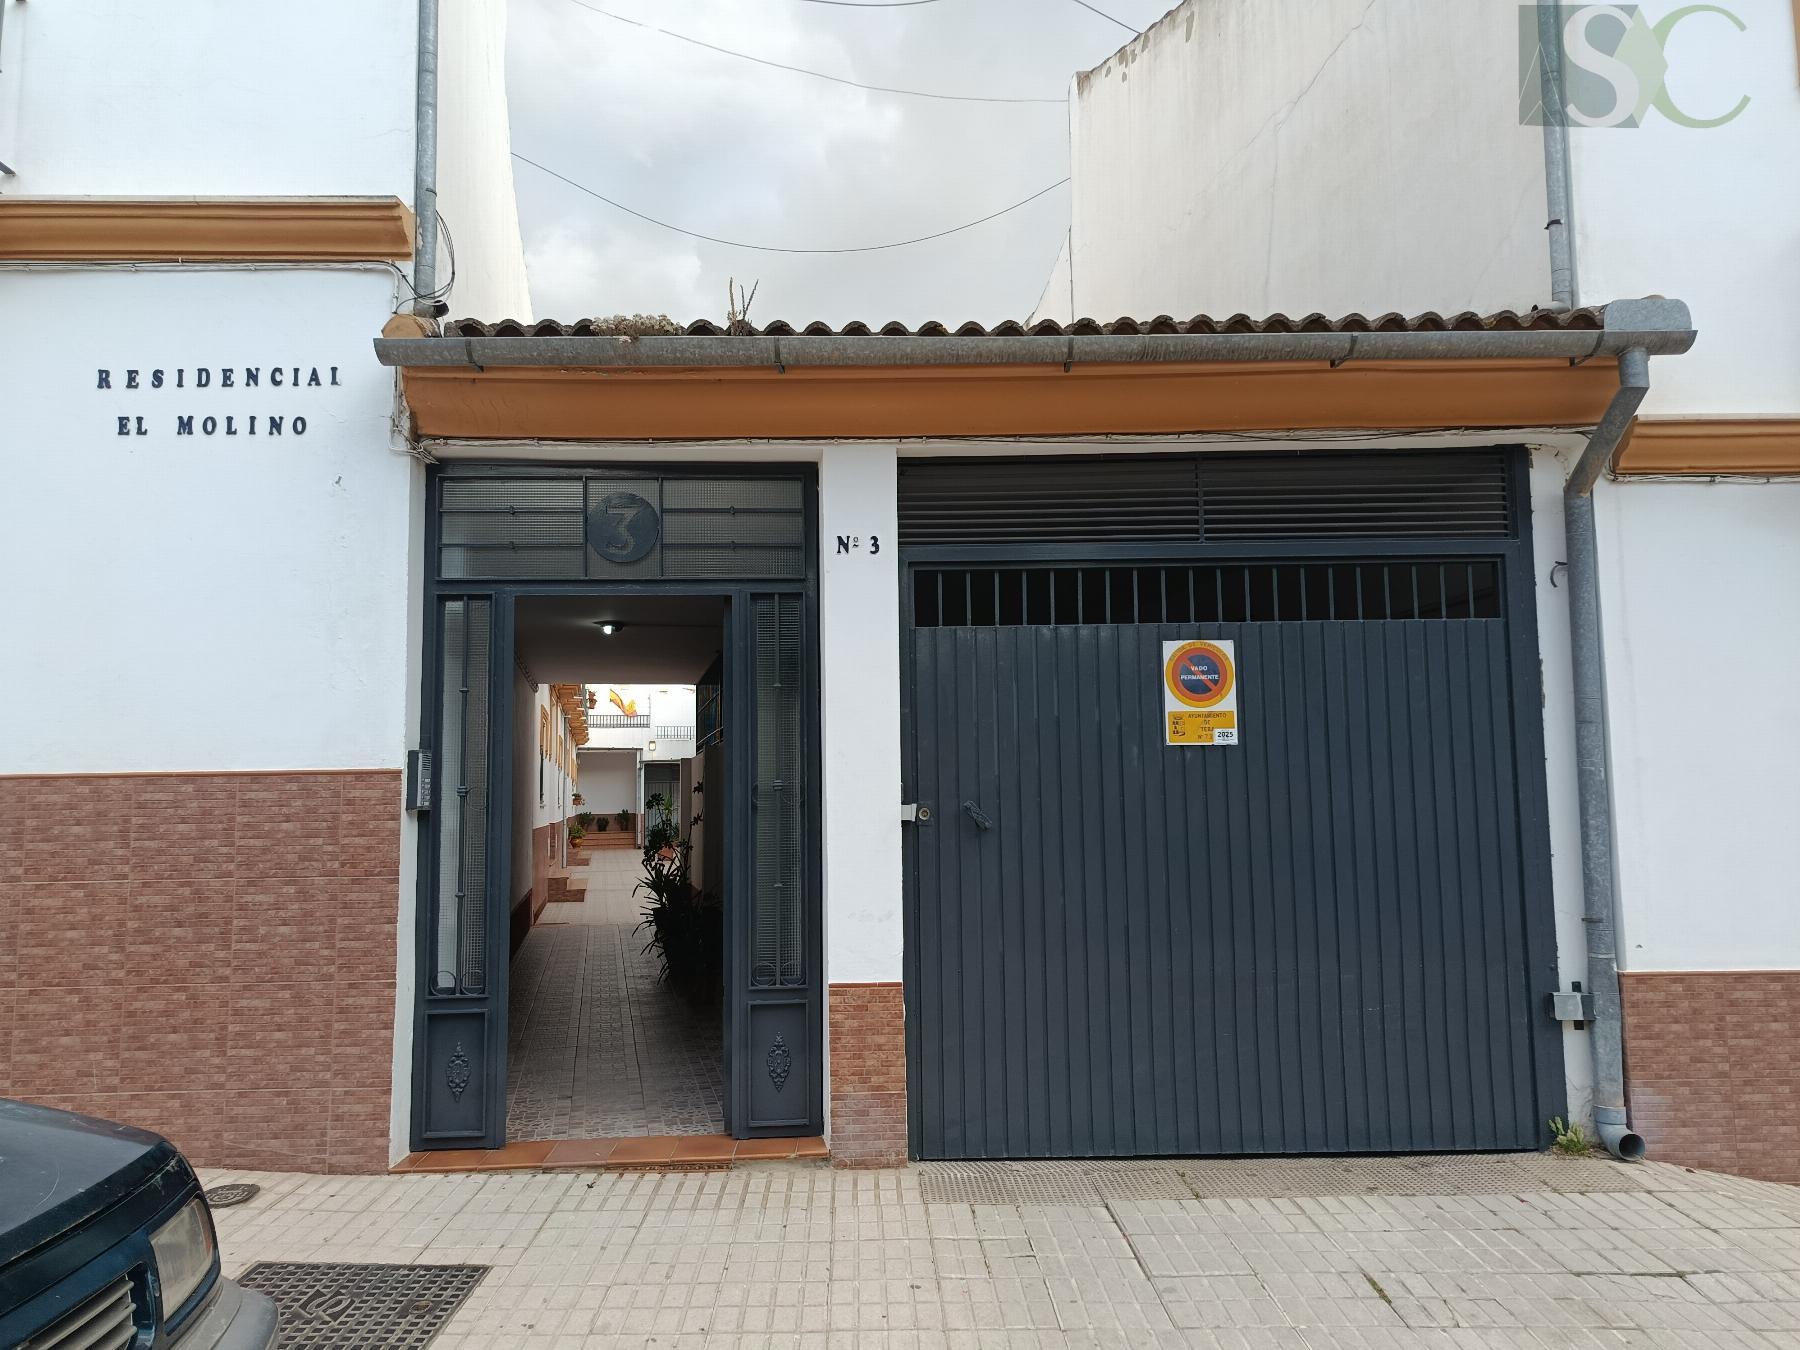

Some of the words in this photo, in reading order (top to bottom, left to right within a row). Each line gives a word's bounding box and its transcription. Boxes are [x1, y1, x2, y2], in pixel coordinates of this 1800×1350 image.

[117, 416, 148, 436] EL
[177, 415, 307, 436] MOLINO
[606, 502, 642, 556] 3
[869, 535, 880, 555] 3
